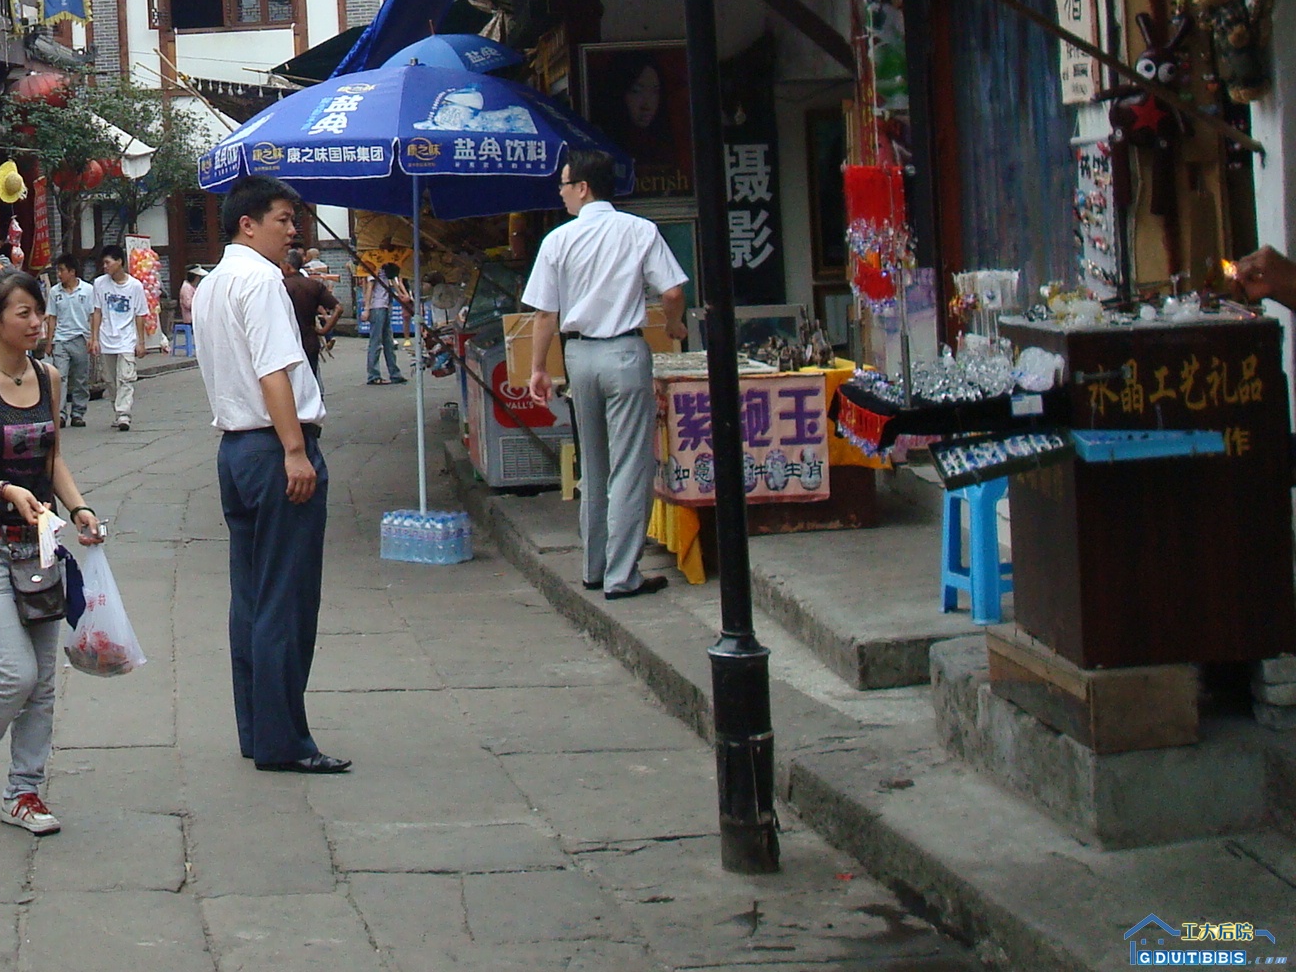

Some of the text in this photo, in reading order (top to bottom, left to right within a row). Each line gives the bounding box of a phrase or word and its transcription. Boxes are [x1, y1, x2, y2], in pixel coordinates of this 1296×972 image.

[287, 146, 385, 163] 康之味国际集团
[453, 137, 547, 162] 盐典饮料
[723, 143, 776, 270] 摄影
[1088, 353, 1264, 416] 水晶工艺礼品
